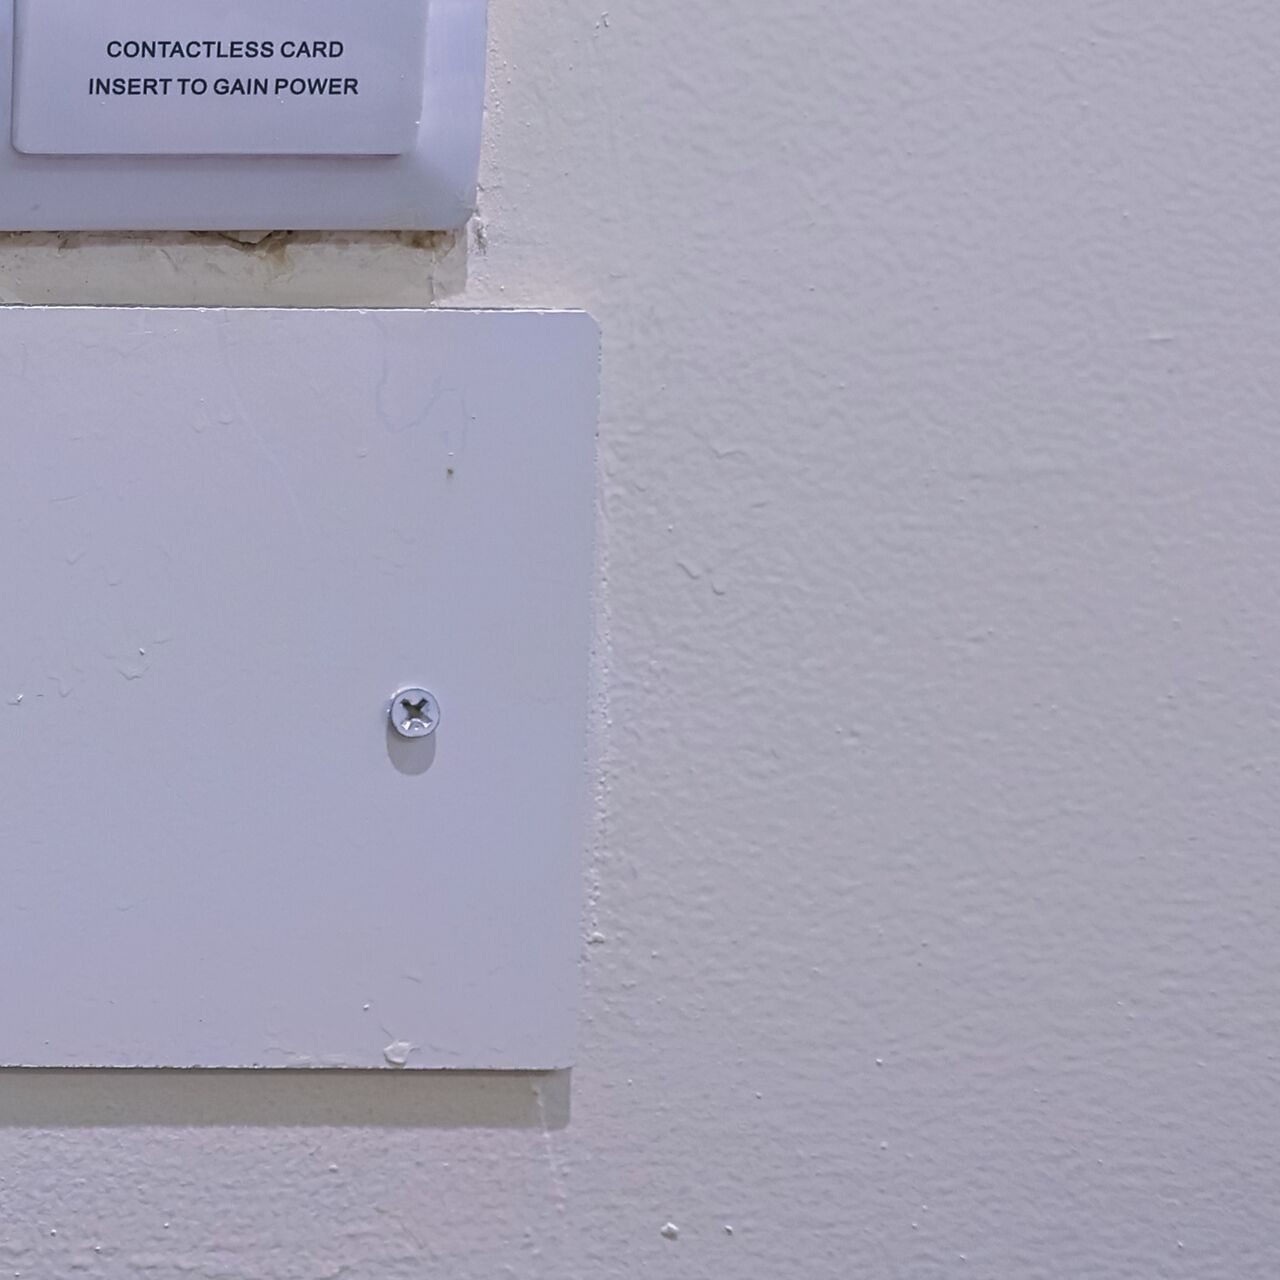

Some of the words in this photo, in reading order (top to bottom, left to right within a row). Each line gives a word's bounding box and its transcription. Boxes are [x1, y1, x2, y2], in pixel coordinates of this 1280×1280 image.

[106, 40, 274, 59] CONTACTLESS
[280, 40, 345, 59] CARD
[88, 77, 172, 96] INSERT
[177, 77, 208, 96] TO
[213, 77, 269, 96] GAIN
[274, 77, 359, 96] POWER
